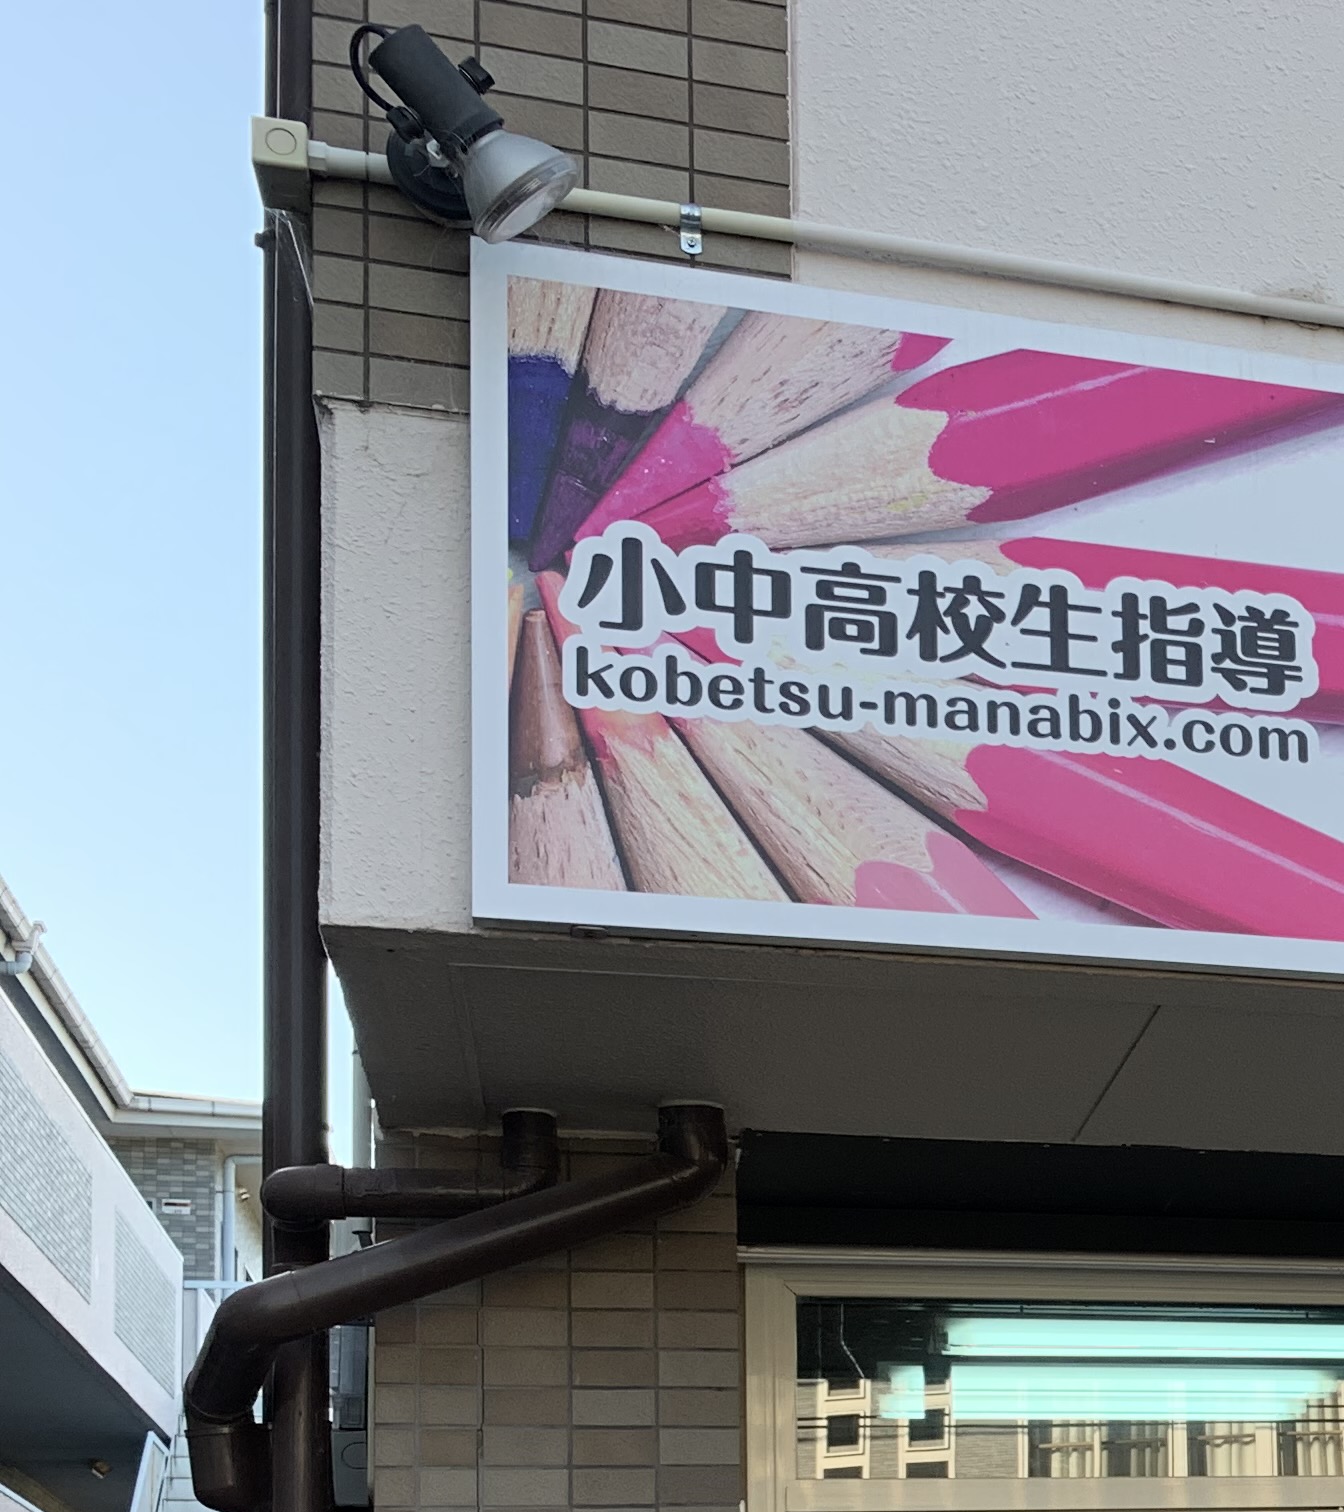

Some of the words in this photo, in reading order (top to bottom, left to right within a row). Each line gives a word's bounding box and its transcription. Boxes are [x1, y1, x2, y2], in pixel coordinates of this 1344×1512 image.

[577, 537, 1305, 697] 小中高校生指導
[576, 646, 1311, 764] kobetsu-manabix.com
